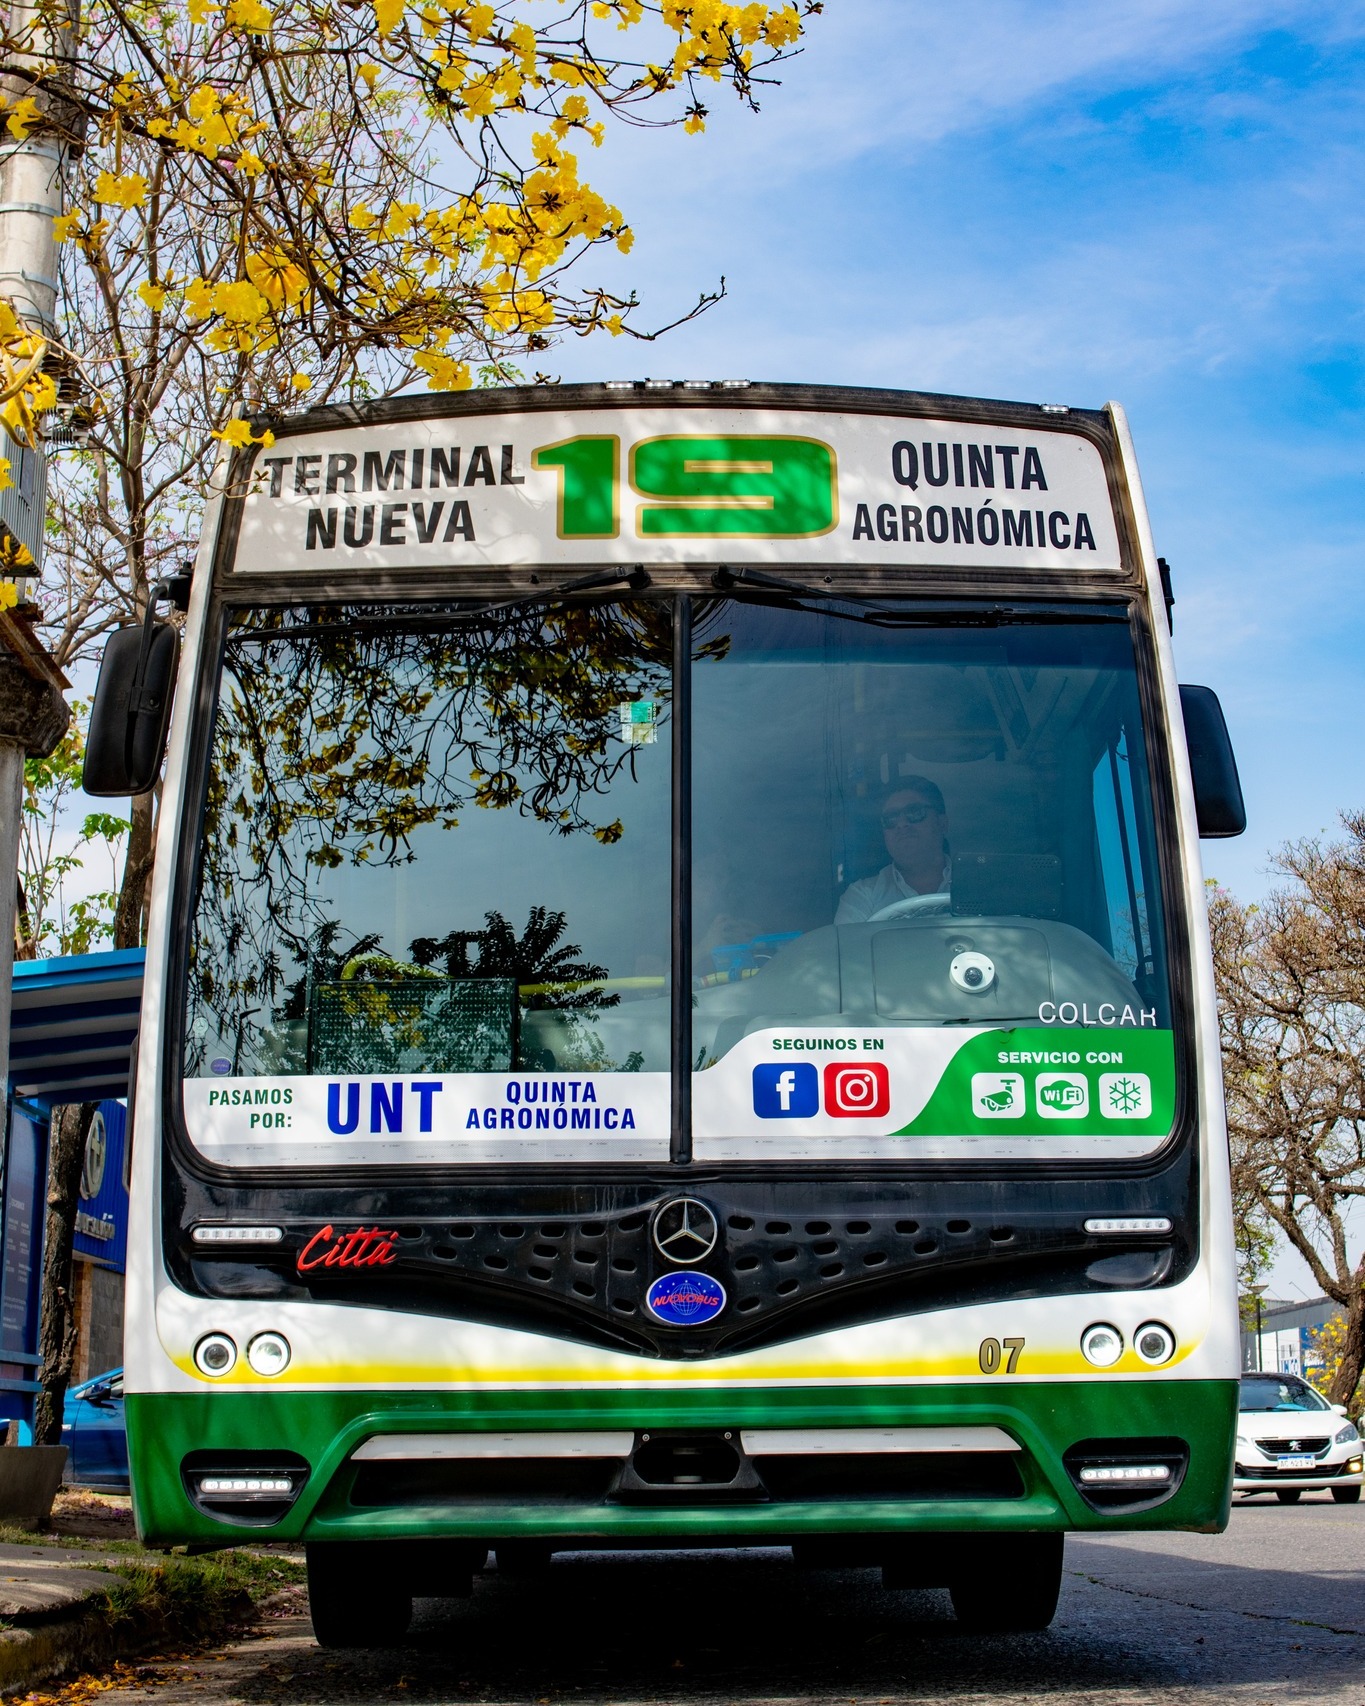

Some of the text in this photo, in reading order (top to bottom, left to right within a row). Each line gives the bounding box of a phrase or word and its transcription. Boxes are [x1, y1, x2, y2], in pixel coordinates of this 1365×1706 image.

[264, 444, 525, 498] TERMINAL
[891, 440, 1048, 491] QUINTA
[531, 434, 840, 540] 19
[305, 500, 476, 550] NUEVA
[852, 499, 1097, 550] AGRONÓMICA
[772, 1038, 884, 1050] SEGUINOS EN
[997, 1051, 1123, 1064] SERVICIO CON
[209, 1088, 293, 1105] PASAMOS
[326, 1081, 443, 1135] UNT
[506, 1081, 597, 1105] QUINTA
[250, 1112, 292, 1128] POR:
[466, 1103, 636, 1129] AGRONÓMICA
[652, 1293, 720, 1307] NUOVOBUS
[979, 1337, 1025, 1374] 07
